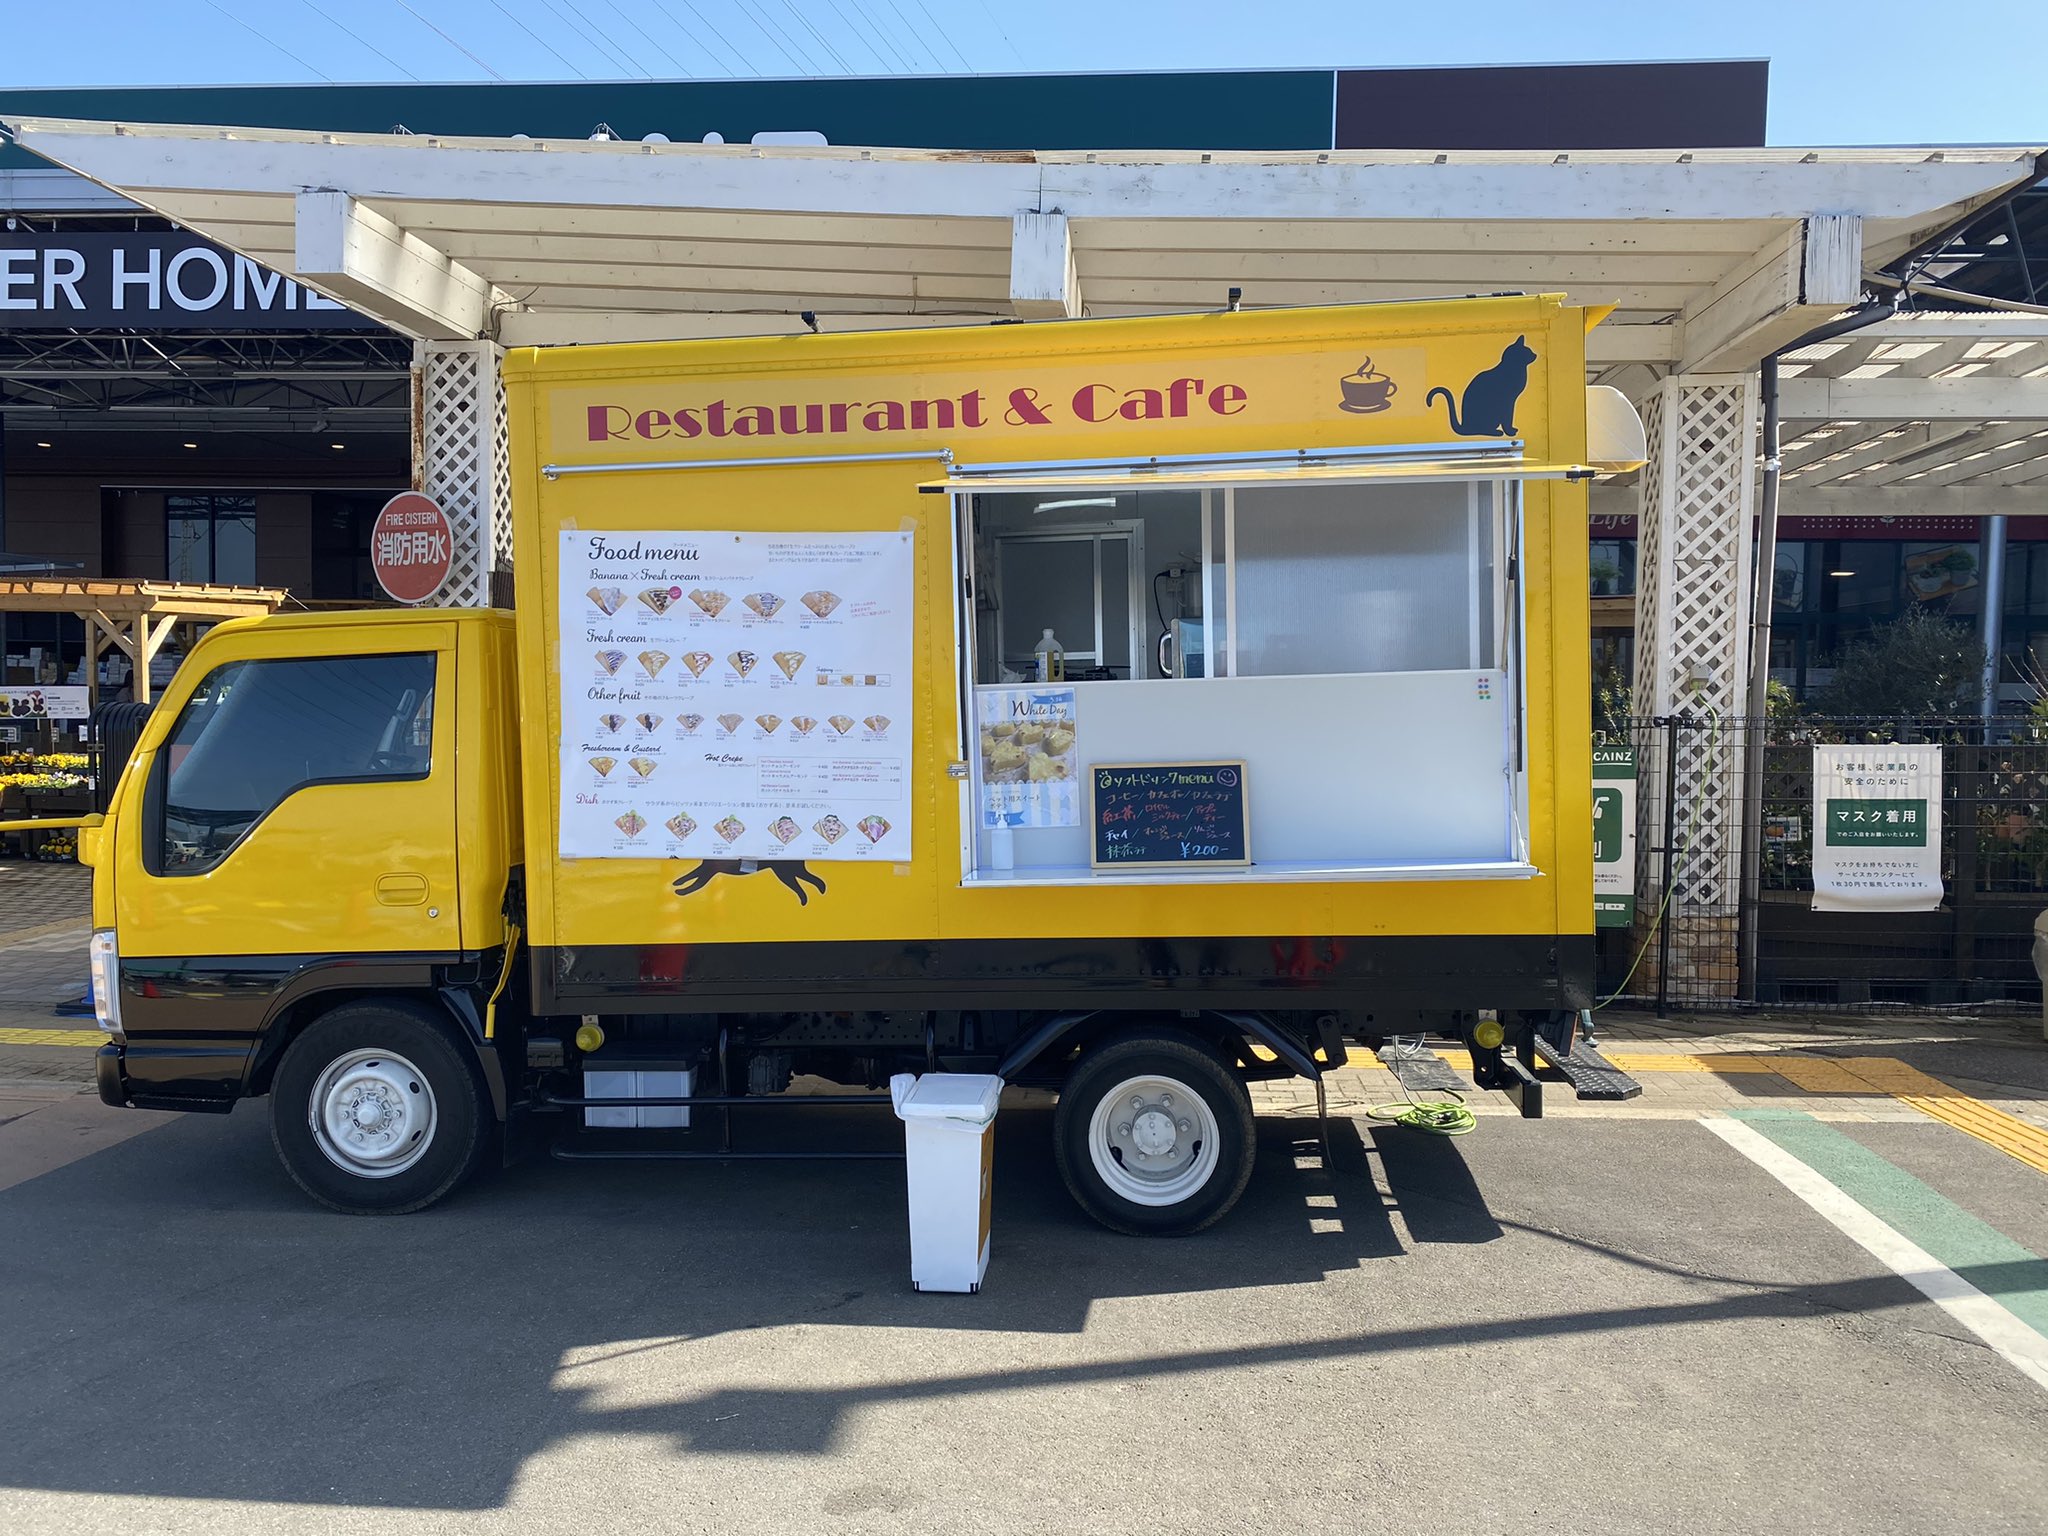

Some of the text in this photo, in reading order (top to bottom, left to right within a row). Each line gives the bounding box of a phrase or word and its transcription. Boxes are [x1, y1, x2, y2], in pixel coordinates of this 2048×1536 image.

[587, 388, 988, 441] Restaurant
[1004, 387, 1052, 425] &
[386, 512, 438, 526] FIRE CISTERN
[377, 530, 447, 566] 消防用水
[588, 536, 699, 560] Food menu
[589, 568, 628, 581] Banana
[640, 568, 668, 581] Fresh
[586, 629, 646, 643] Fresh cream
[587, 687, 641, 704] Other fruit
[1011, 699, 1067, 718] White Day
[624, 744, 630, 752] &
[632, 744, 661, 753] Custard
[704, 753, 743, 763] Hot Crepe
[1592, 751, 1632, 761] CAINZ
[1835, 762, 1918, 772] お客様、従業員の
[1844, 777, 1909, 786] 安全のために
[575, 792, 599, 805] Dish
[1836, 810, 1917, 823] マスク着用
